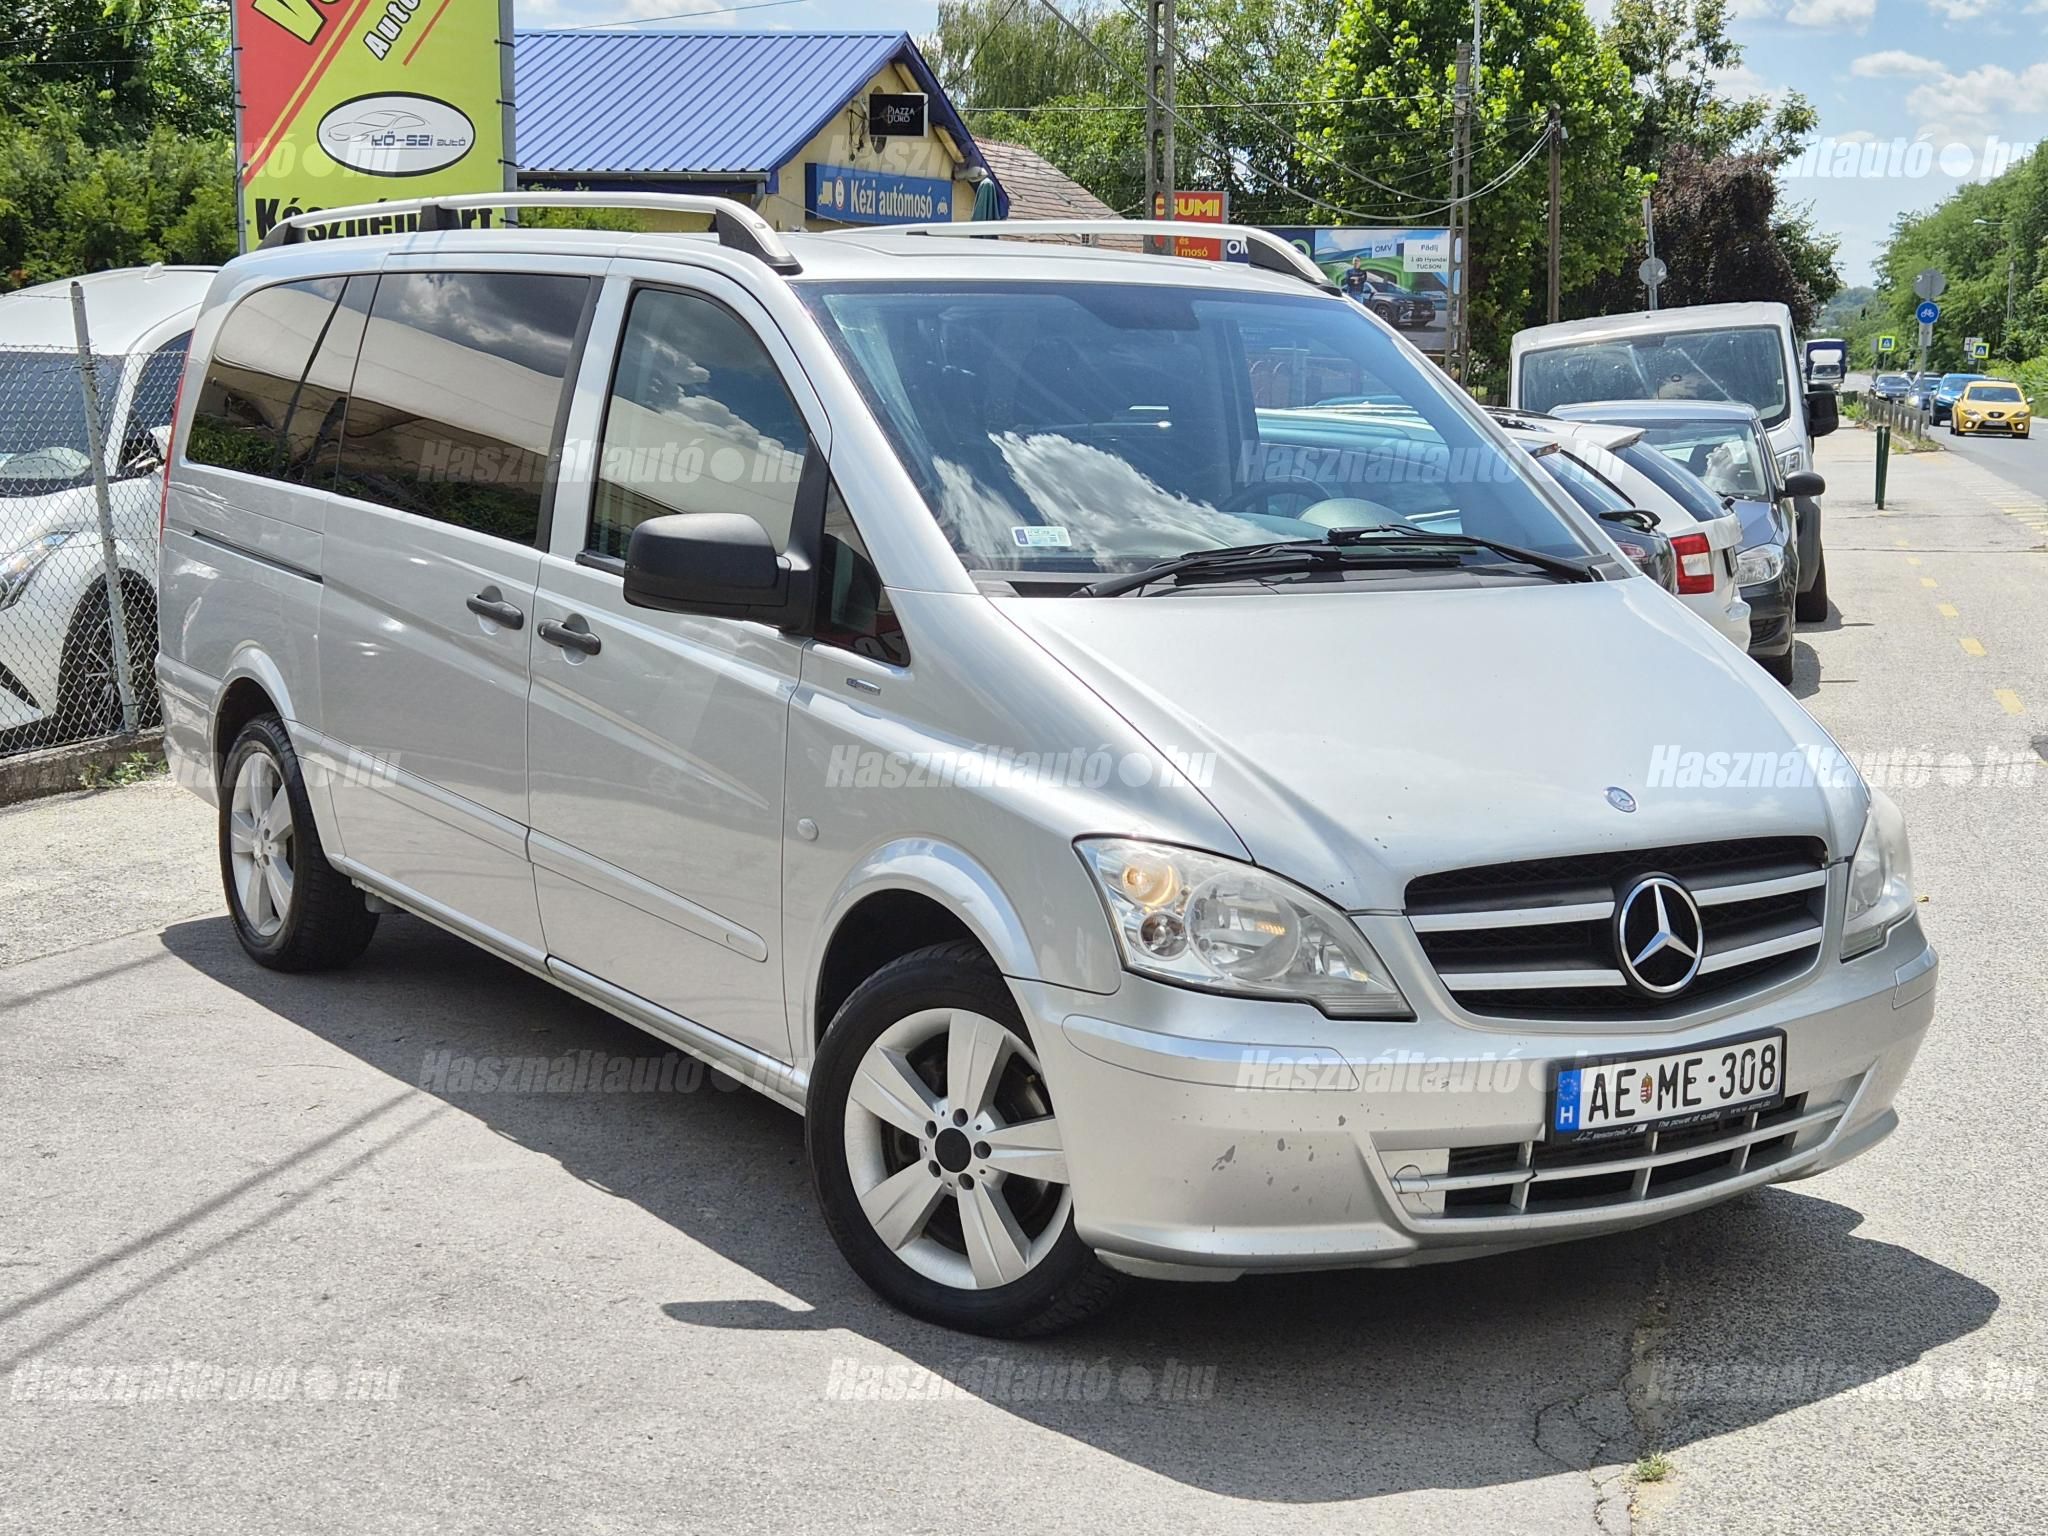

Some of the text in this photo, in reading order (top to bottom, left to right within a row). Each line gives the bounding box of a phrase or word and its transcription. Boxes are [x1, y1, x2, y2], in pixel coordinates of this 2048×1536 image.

[850, 178, 933, 219] Kézi autómosó
[1181, 246, 1208, 257] mosó
[1374, 244, 1393, 253] OMV
[1588, 1068, 1637, 1123] AE
[1560, 1105, 1574, 1125] H
